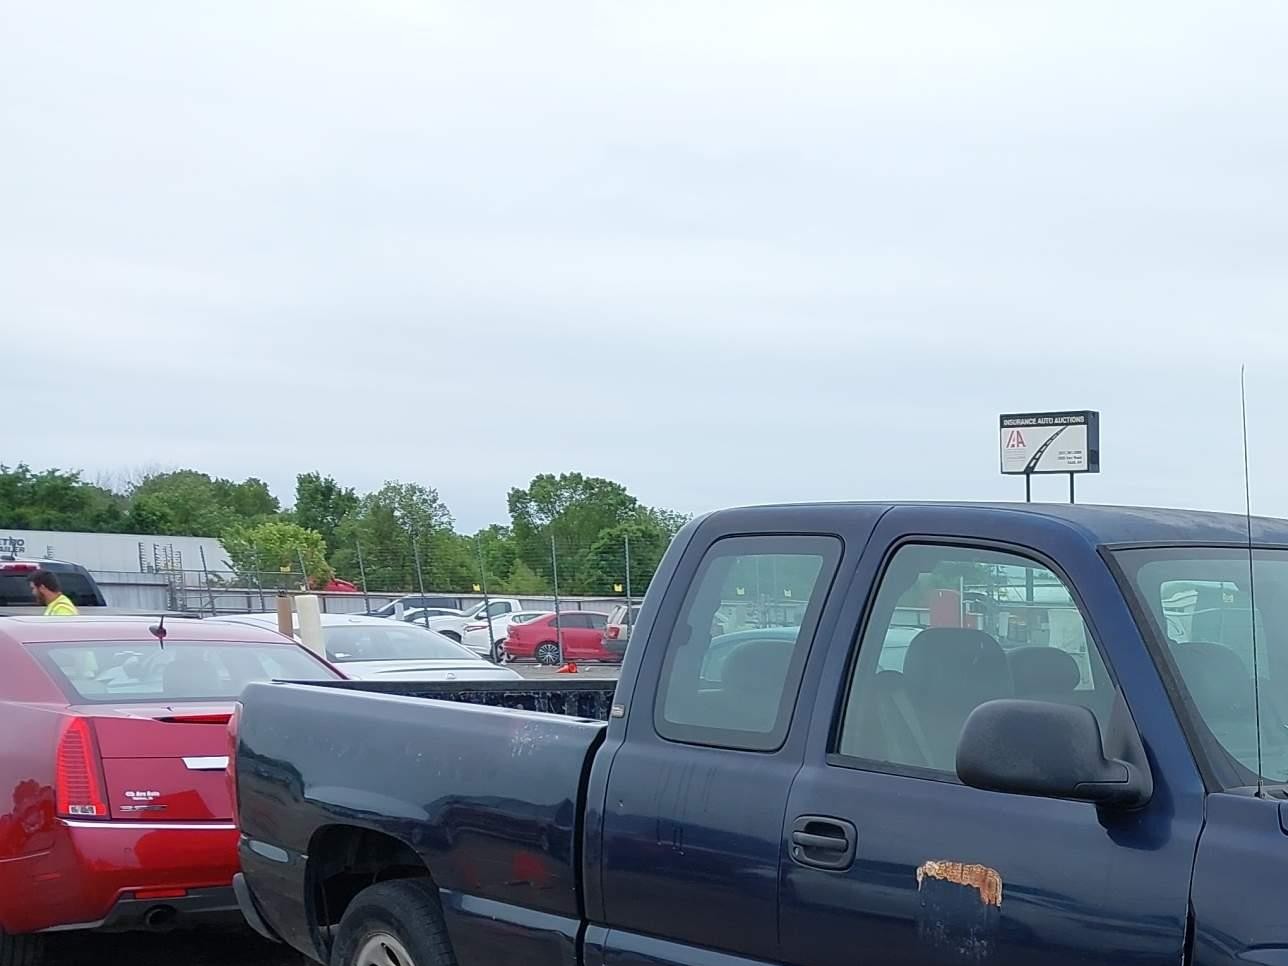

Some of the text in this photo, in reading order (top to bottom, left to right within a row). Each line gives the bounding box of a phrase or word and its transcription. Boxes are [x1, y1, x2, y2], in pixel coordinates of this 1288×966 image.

[1003, 416, 1085, 426] INSURANCE AUTO AUCTIONS
